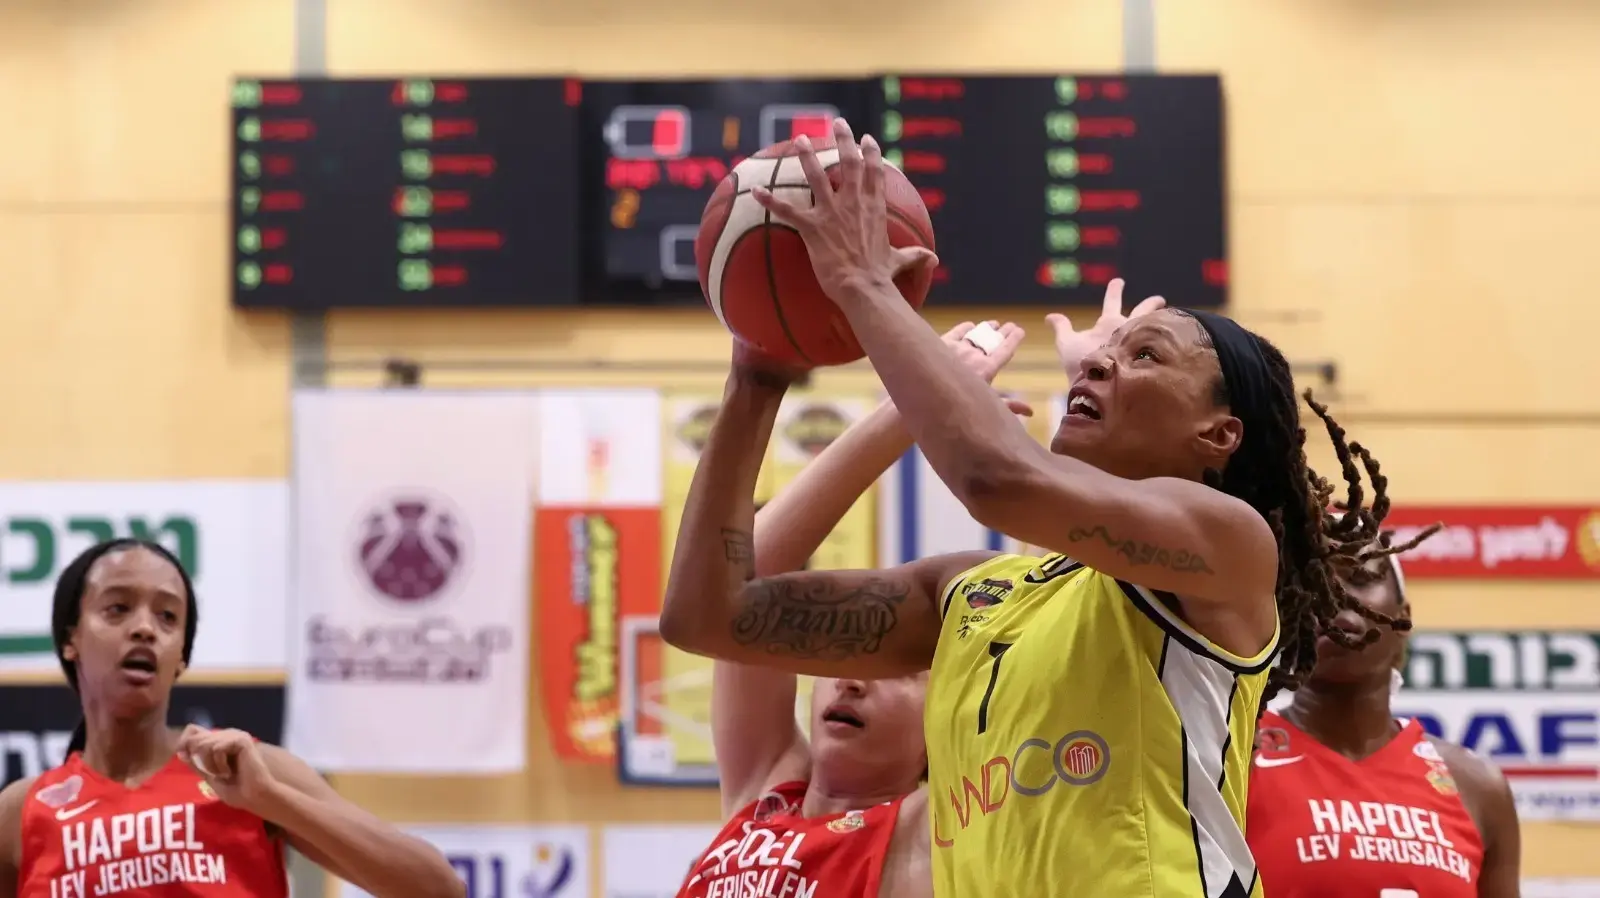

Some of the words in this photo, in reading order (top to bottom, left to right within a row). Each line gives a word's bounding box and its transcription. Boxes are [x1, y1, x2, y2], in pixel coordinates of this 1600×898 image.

[62, 803, 203, 870] HAPOEL
[1308, 799, 1453, 848] HAPOEL
[93, 852, 226, 896] JERUSALEM
[1296, 834, 1340, 863] LEV
[1350, 835, 1471, 883] JERUSALEM
